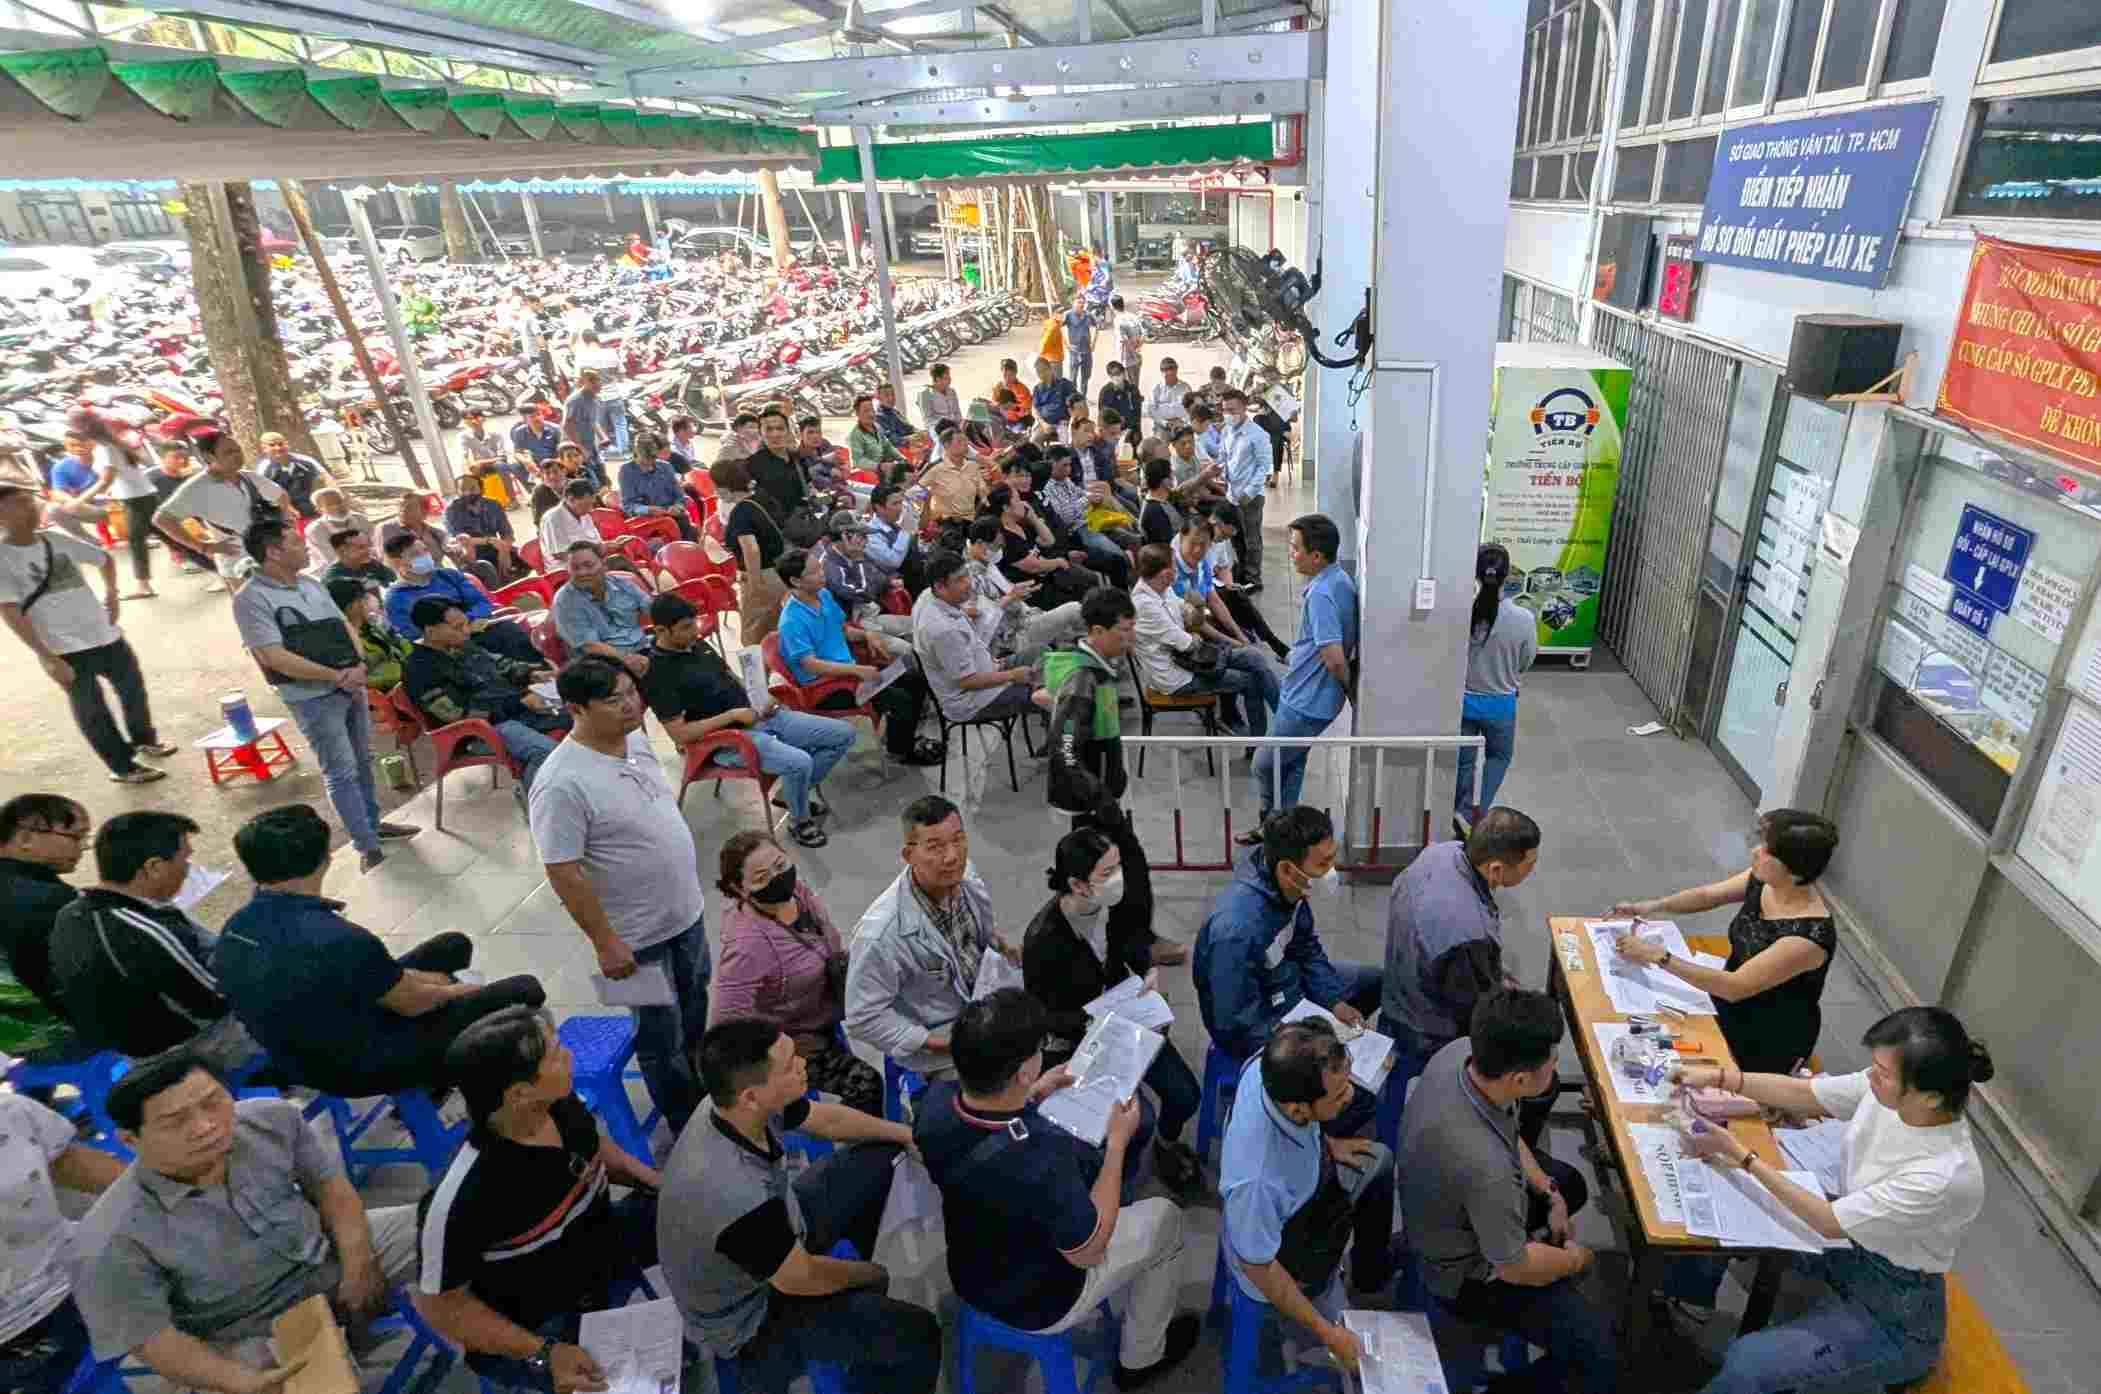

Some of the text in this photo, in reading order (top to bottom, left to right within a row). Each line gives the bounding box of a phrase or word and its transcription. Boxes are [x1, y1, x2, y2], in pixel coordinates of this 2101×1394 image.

[1742, 141, 1765, 161] GIAO
[1764, 135, 1801, 159] THÔNG
[1847, 132, 1866, 154] TP.
[1868, 127, 1901, 151] HCM
[1773, 164, 1805, 208] TIẾP
[1802, 165, 1852, 217] NHẬN
[1823, 223, 1857, 270] LÁI
[1851, 235, 1882, 273] XE
[1552, 415, 1577, 427] TB
[1528, 470, 1562, 487] TIẾN
